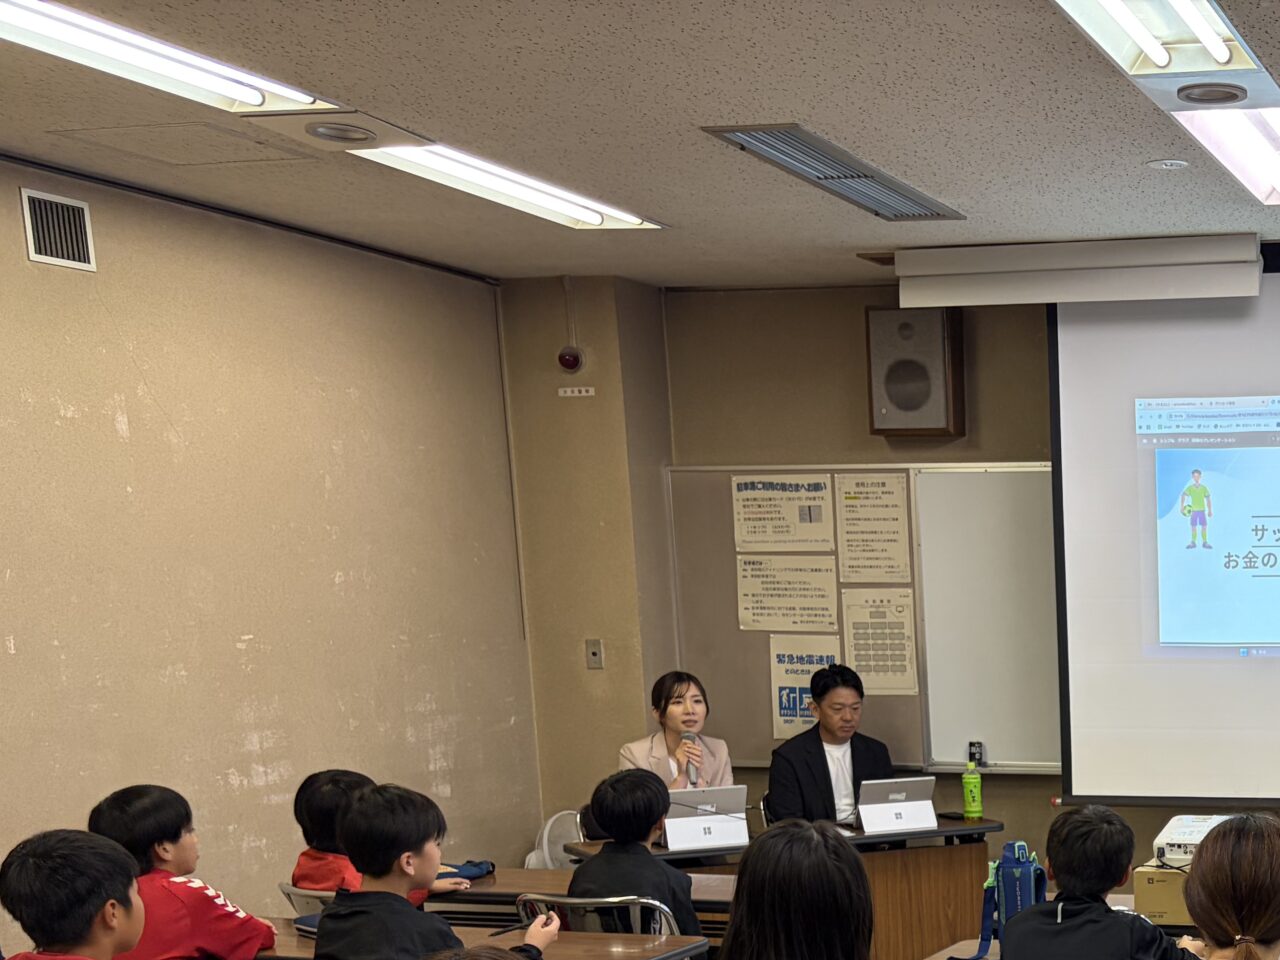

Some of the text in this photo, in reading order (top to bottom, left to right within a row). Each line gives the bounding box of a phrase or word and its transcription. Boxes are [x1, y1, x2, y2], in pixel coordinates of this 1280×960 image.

[776, 653, 835, 665] 緊急地震速報
